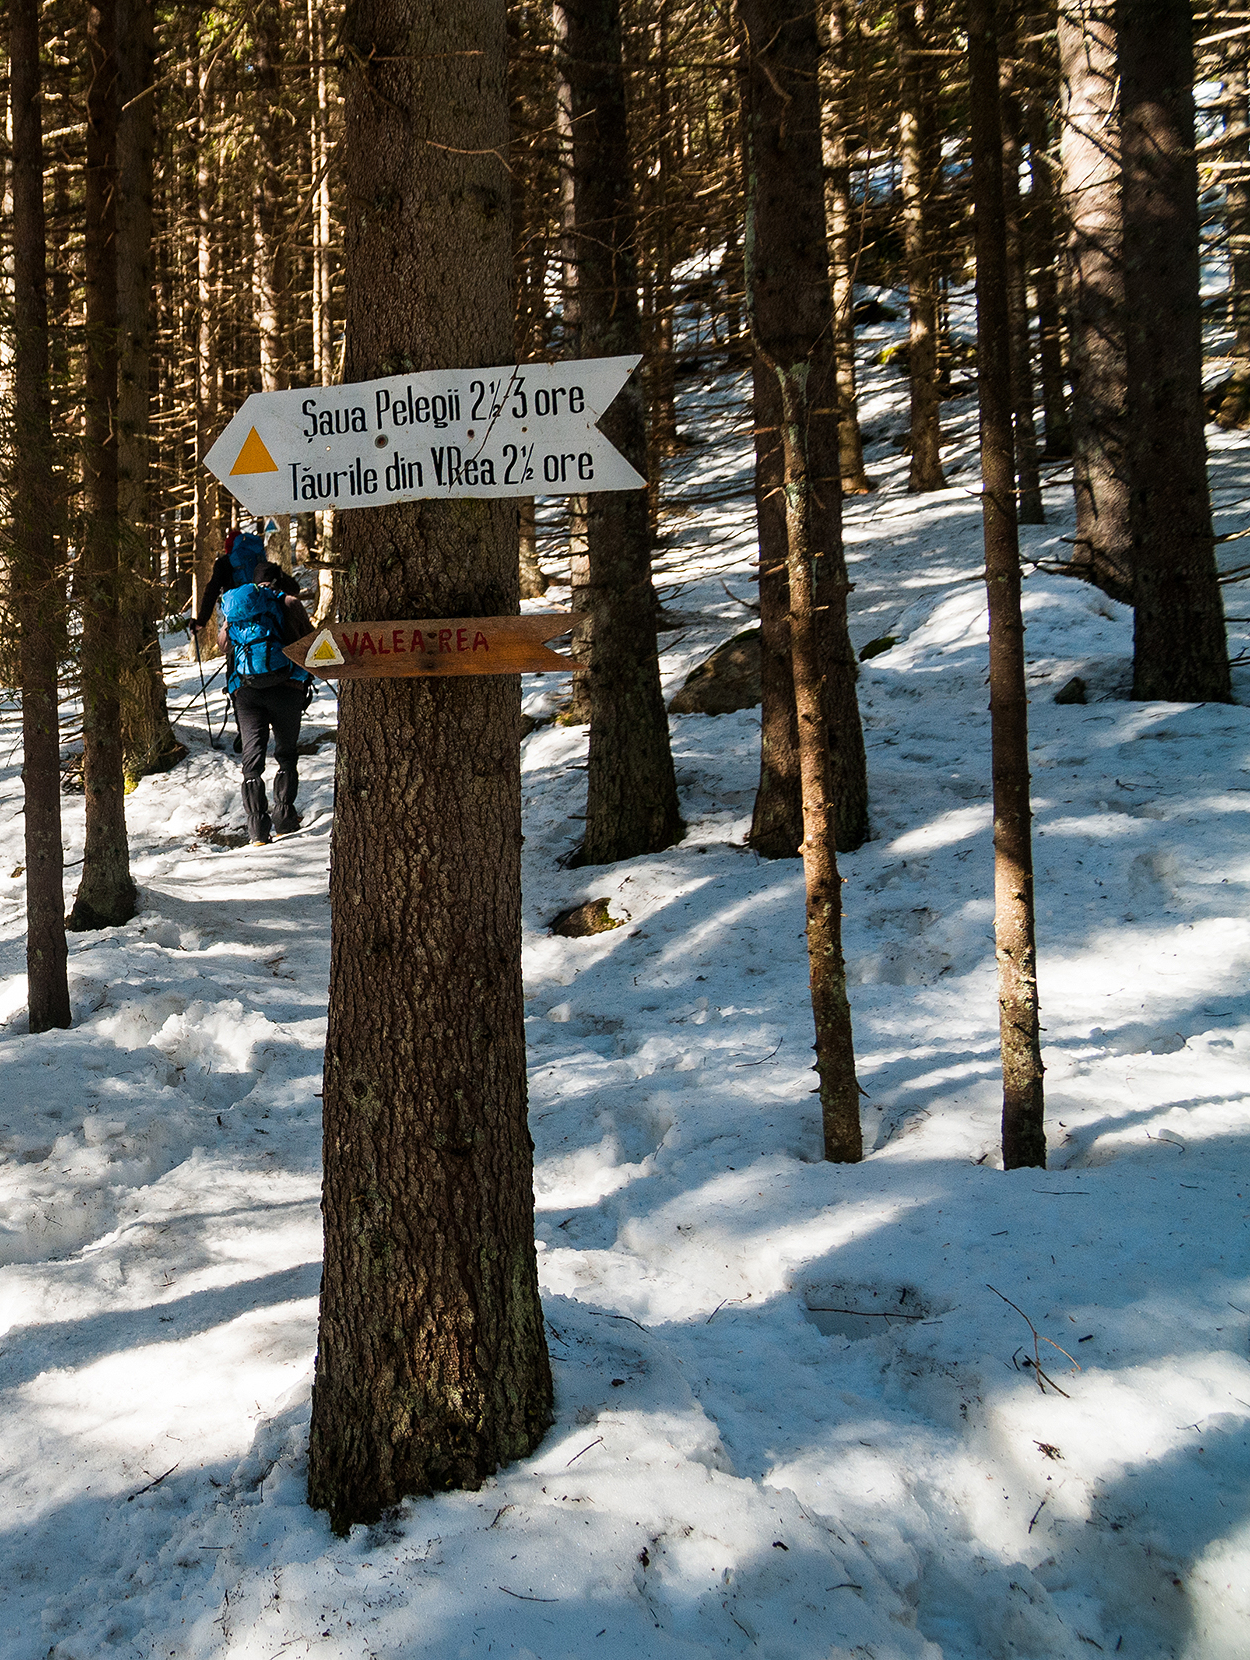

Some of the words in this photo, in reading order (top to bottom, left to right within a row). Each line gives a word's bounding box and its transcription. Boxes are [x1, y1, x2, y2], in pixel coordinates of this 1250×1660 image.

[375, 385, 461, 430] Pelegii
[534, 386, 585, 416] ore
[288, 457, 378, 501] Tăurile
[385, 451, 424, 492] din
[543, 452, 594, 482] ore
[341, 629, 426, 657] VALEA
[438, 628, 490, 653] REA
